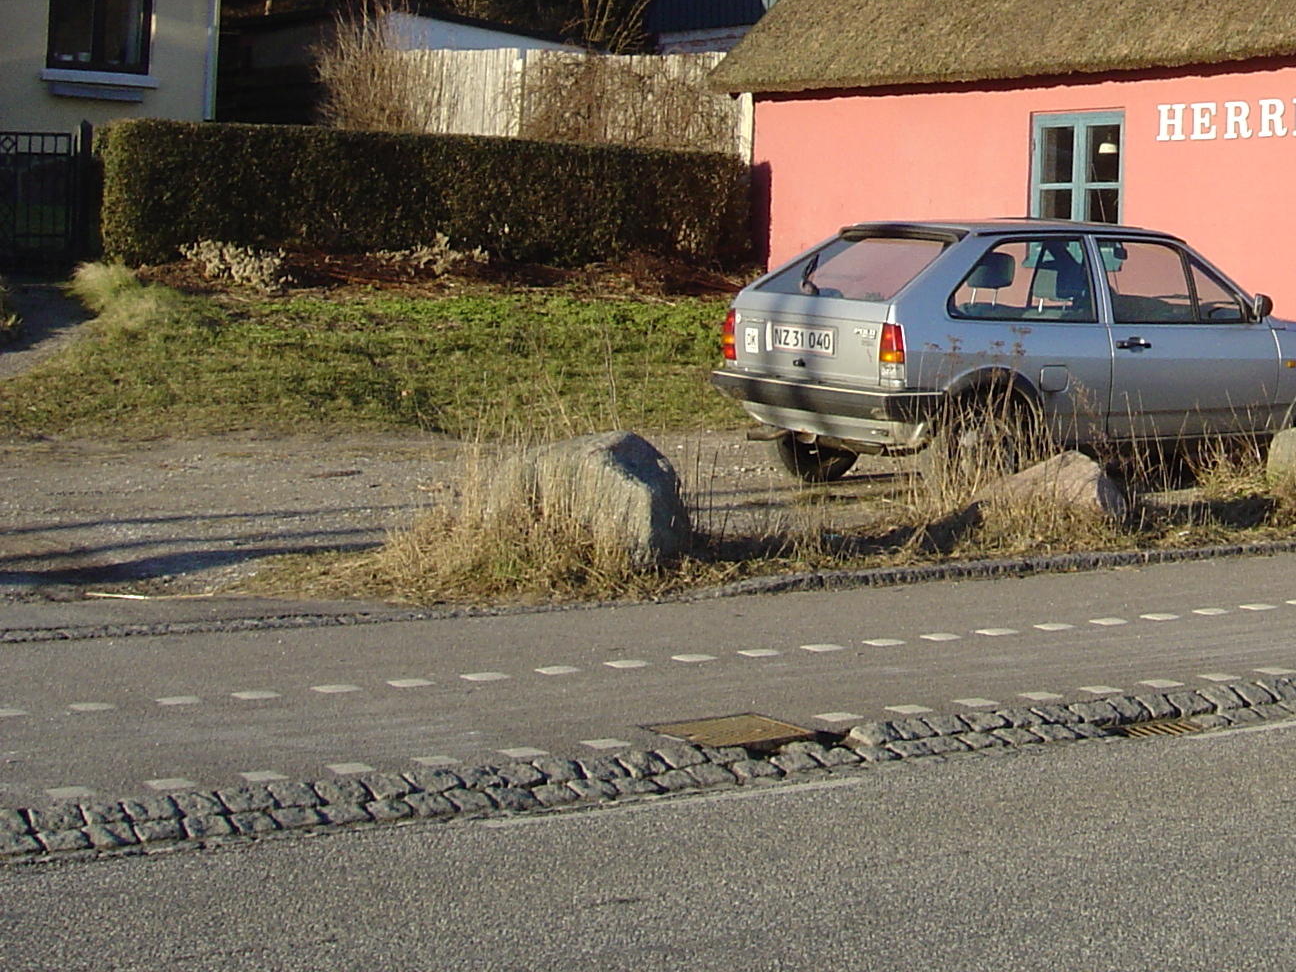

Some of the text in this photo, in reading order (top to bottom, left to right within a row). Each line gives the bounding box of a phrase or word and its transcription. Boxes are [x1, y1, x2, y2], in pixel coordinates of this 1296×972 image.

[774, 328, 831, 350] NZ 31 040
